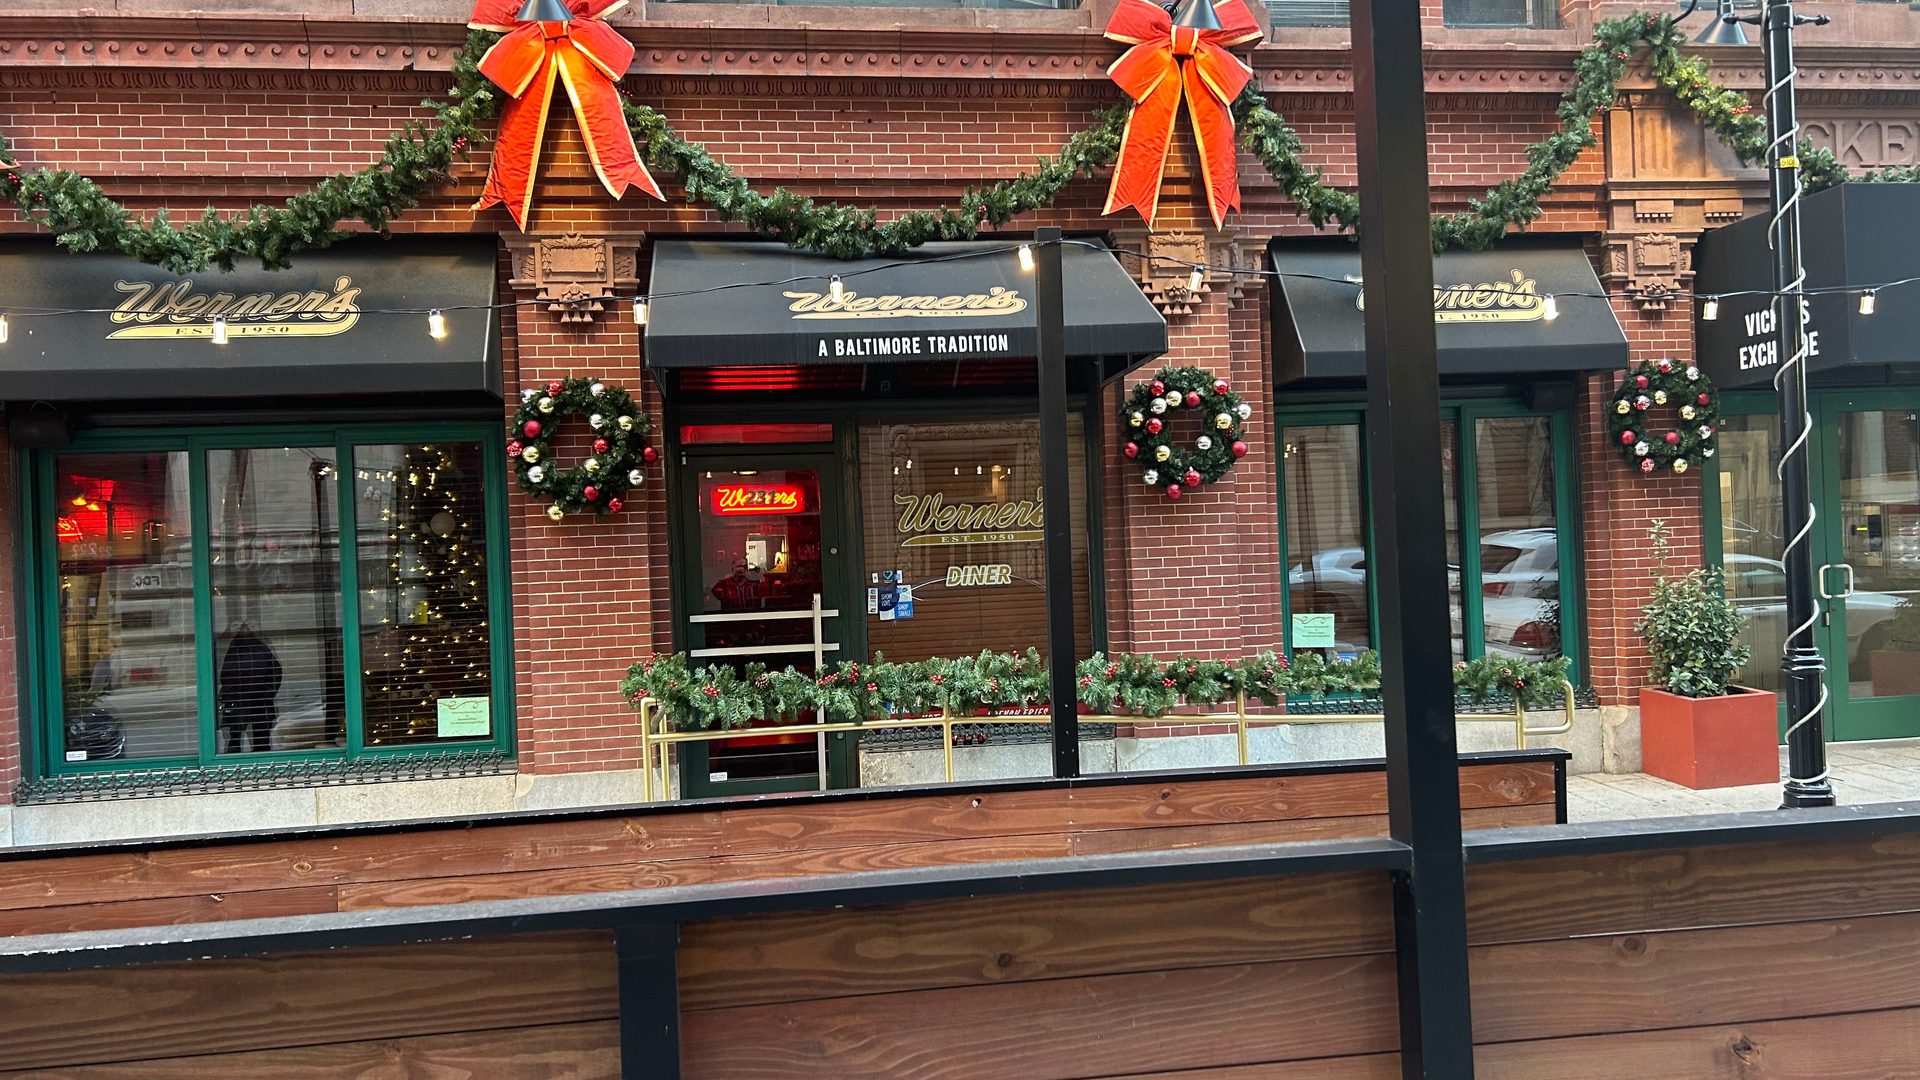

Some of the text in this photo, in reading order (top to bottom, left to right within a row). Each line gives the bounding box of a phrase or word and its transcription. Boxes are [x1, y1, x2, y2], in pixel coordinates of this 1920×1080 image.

[111, 275, 361, 323] Werner's
[783, 286, 1028, 312] Werner's
[241, 326, 290, 334] 1950
[818, 334, 1009, 357] A BALTIMORE TRADITION
[894, 487, 1045, 533] Werner's
[941, 533, 1015, 543] EST. 1950
[945, 563, 1012, 587] DINER
